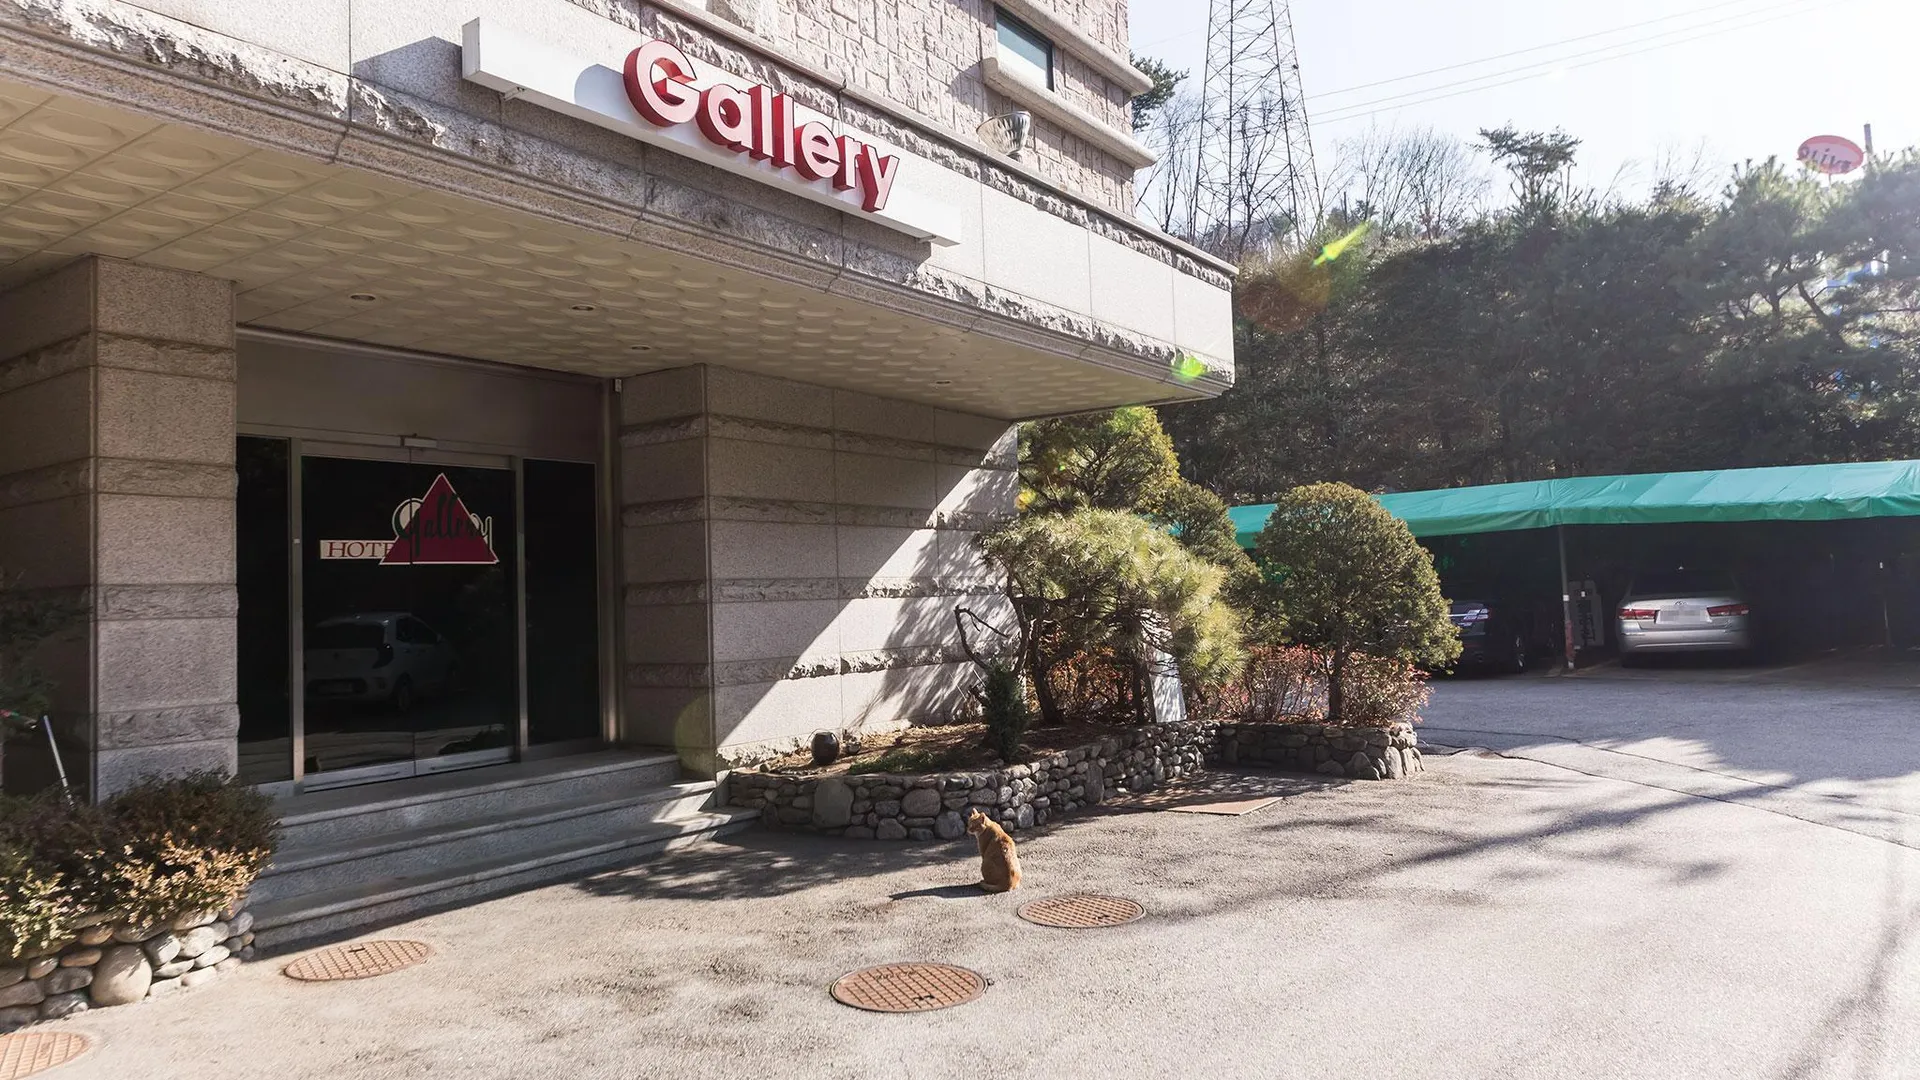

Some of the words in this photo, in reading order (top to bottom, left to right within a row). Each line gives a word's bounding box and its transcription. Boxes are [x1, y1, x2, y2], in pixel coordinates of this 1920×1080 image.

[623, 40, 900, 212] Gallery
[327, 541, 395, 558] HOTE
[393, 492, 492, 558] Gallery
